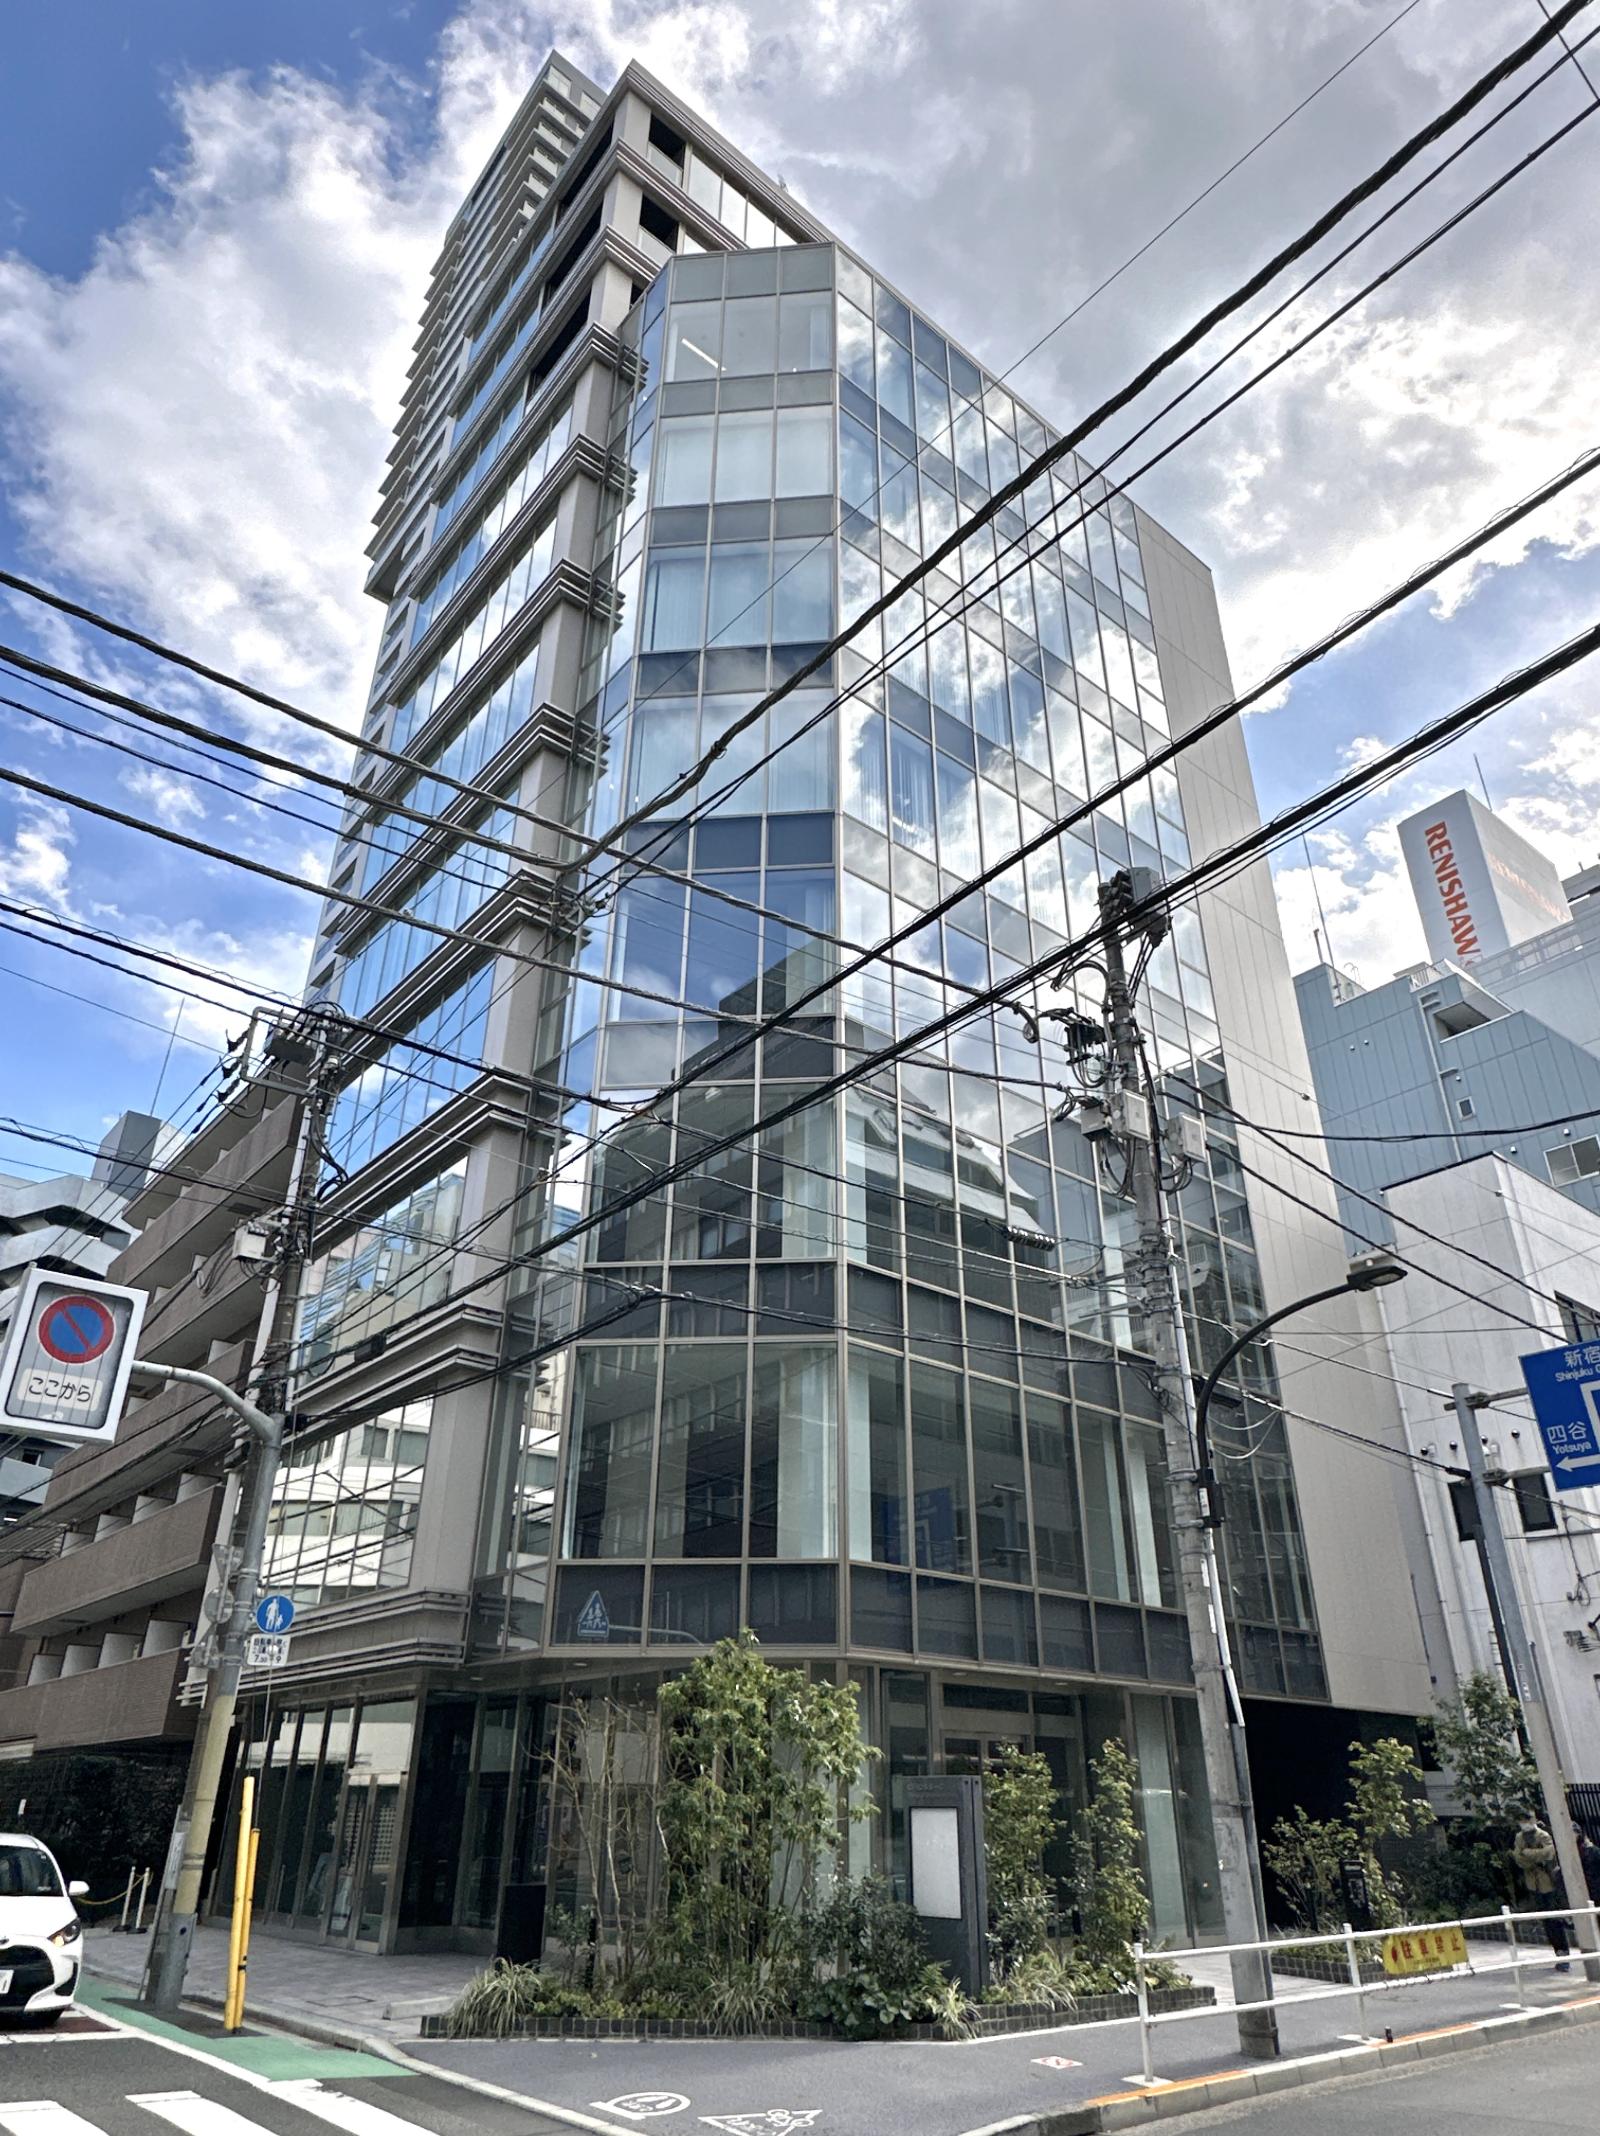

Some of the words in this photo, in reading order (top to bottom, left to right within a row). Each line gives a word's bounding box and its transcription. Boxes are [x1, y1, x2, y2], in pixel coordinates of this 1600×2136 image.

[1424, 820, 1481, 956] RENISHAW
[1555, 1368, 1594, 1382] Shinjuku
[28, 1376, 91, 1403] ここから
[1547, 1421, 1587, 1444] 四谷
[1552, 1441, 1592, 1455] Yotsuya
